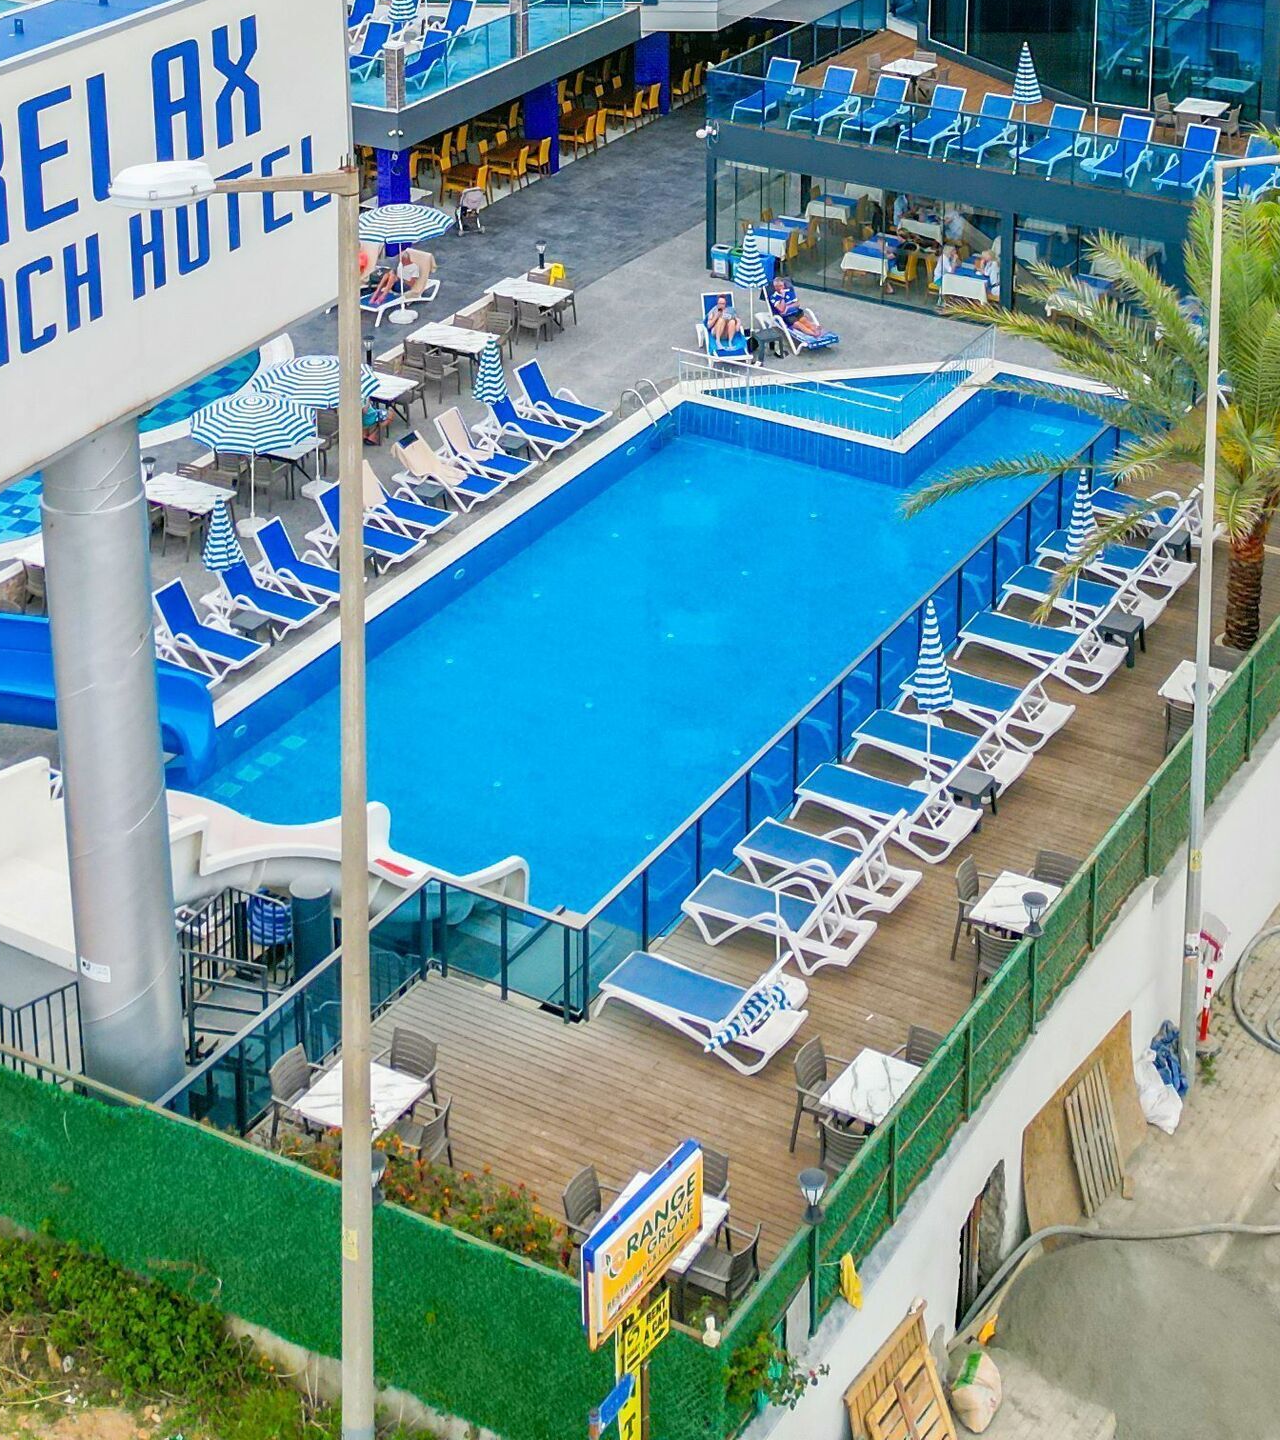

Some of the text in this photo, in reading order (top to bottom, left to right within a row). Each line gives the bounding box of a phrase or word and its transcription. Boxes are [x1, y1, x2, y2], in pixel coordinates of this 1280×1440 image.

[129, 135, 332, 301] HOTEL
[647, 1197, 694, 1256] GROVE
[646, 1299, 666, 1325] RENT
[652, 1309, 668, 1331] CAR
